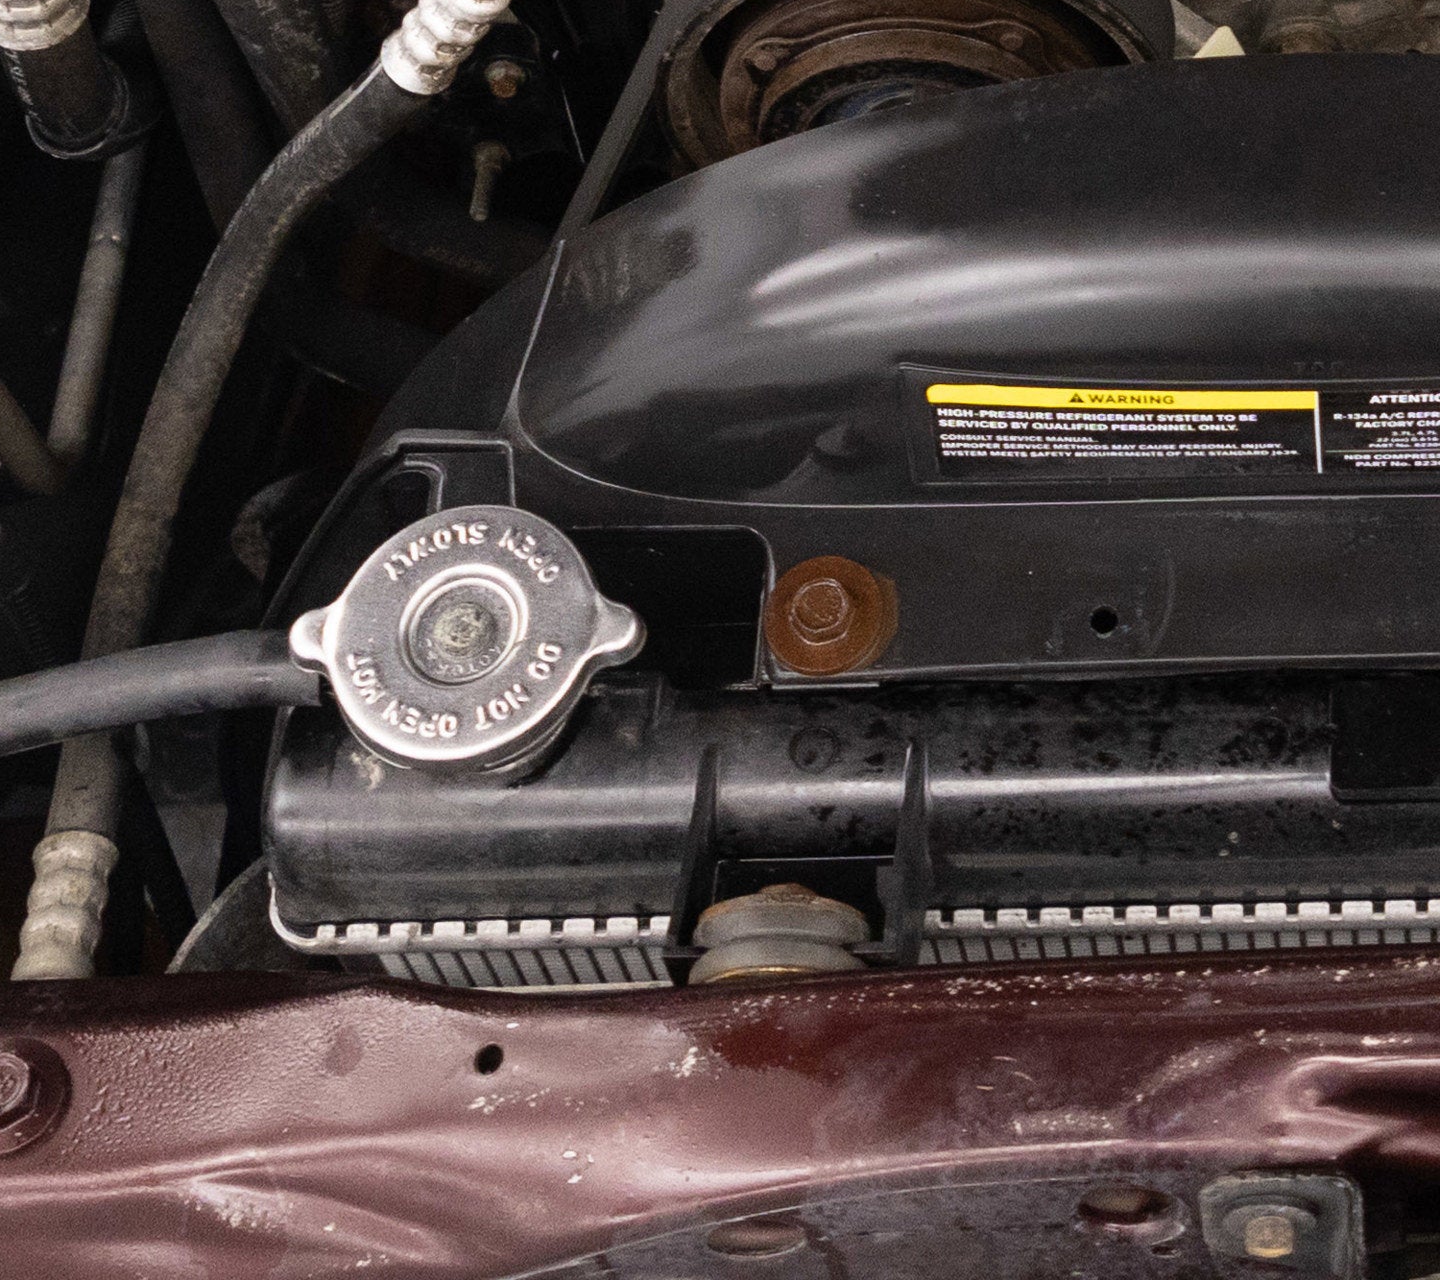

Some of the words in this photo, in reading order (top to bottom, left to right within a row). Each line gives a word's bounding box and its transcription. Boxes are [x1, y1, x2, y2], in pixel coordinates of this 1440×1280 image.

[1087, 393, 1176, 406] WARNING
[937, 408, 1053, 421] HIGH-PRESSURE
[1055, 412, 1154, 422] REFRIGERANT
[1156, 413, 1213, 423] SYSTEM
[1215, 413, 1236, 423] TO
[1238, 413, 1258, 423] BE
[1379, 412, 1405, 421] A/C
[938, 419, 1008, 430] SERVICED
[1010, 421, 1029, 430] BY
[1031, 421, 1108, 432] QUALIFIED
[1111, 422, 1196, 432] PERSONNEL
[1198, 422, 1239, 432] ONLY.
[1355, 420, 1415, 428] FACTORY
[939, 433, 993, 441] CONSULT
[995, 434, 1044, 442] SERVICE
[1074, 450, 1164, 458] REQUIREMENTS
[382, 521, 491, 582] SLOWLY
[498, 527, 561, 584] OPEN
[527, 641, 562, 681] DO
[345, 652, 386, 705] HOT
[474, 683, 530, 732] NOT
[382, 698, 460, 740] OPEN
